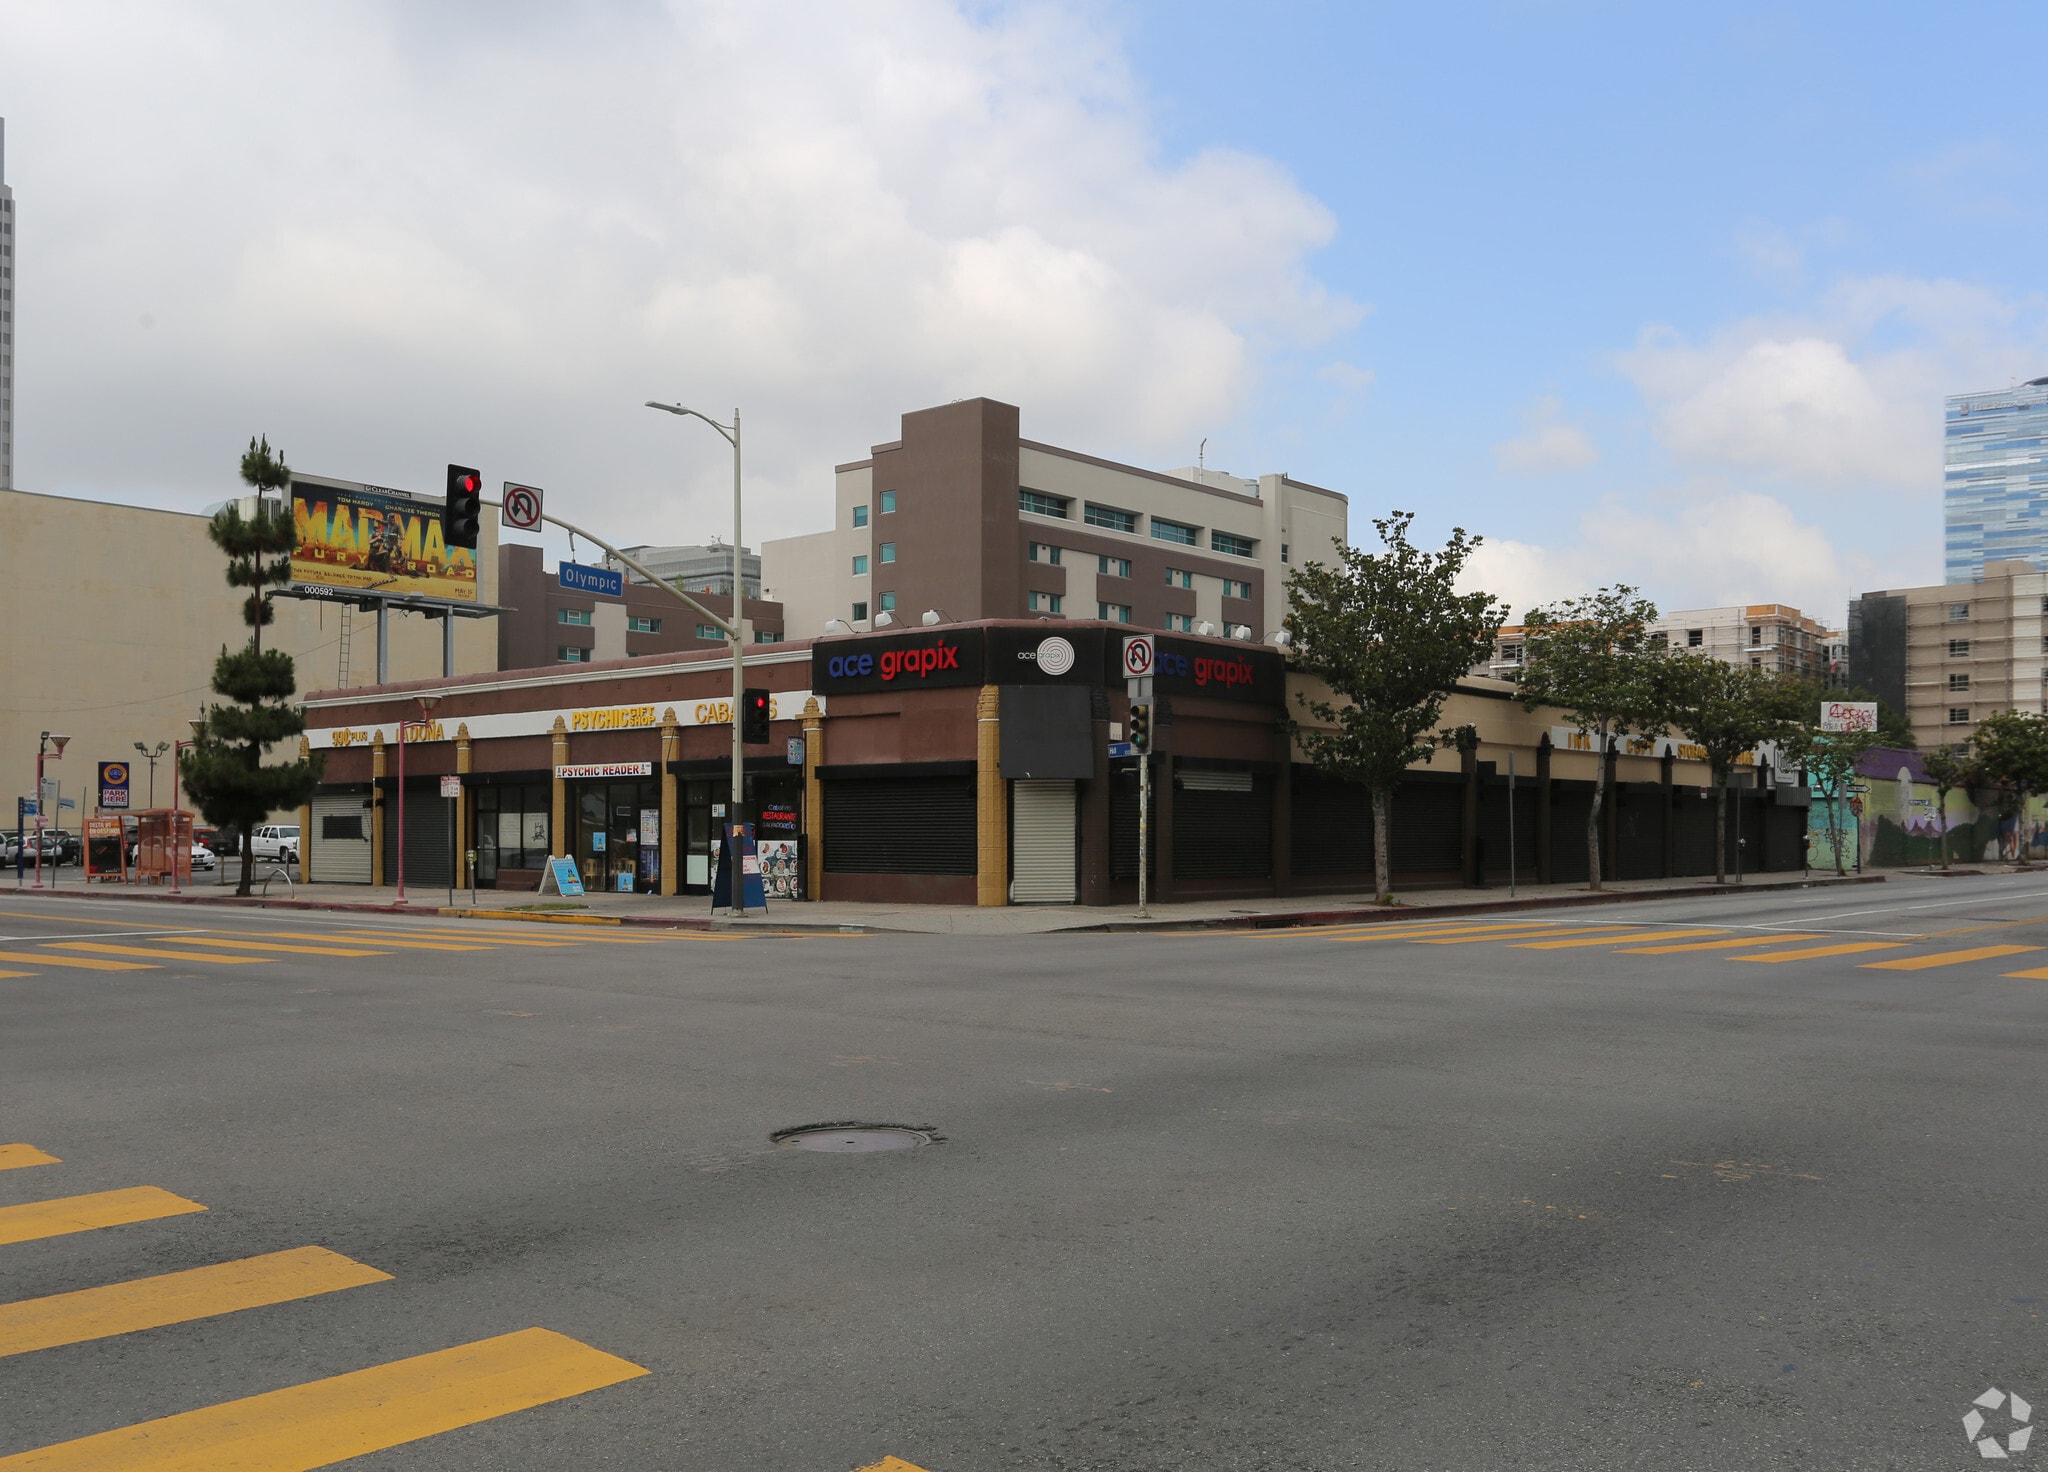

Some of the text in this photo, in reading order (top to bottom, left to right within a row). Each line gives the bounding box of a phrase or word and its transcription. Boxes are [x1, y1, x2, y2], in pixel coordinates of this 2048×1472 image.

[352, 499, 374, 507] HARDY
[385, 504, 415, 514] CHARLIZE
[416, 510, 440, 518] THERON
[293, 496, 384, 554] MAD
[293, 546, 475, 579] FURY ROAD
[566, 568, 617, 591] Olympic
[304, 585, 334, 596] 000592
[828, 639, 960, 681] ace grapix
[1017, 652, 1037, 660] ace
[1194, 655, 1255, 689] grapix
[572, 706, 656, 731] PSYCHIC GIFT
[628, 715, 656, 727] SHOP
[1567, 732, 1592, 750] INK
[1677, 743, 1709, 759] STORAG
[562, 764, 640, 777] PSYCHIC READER
